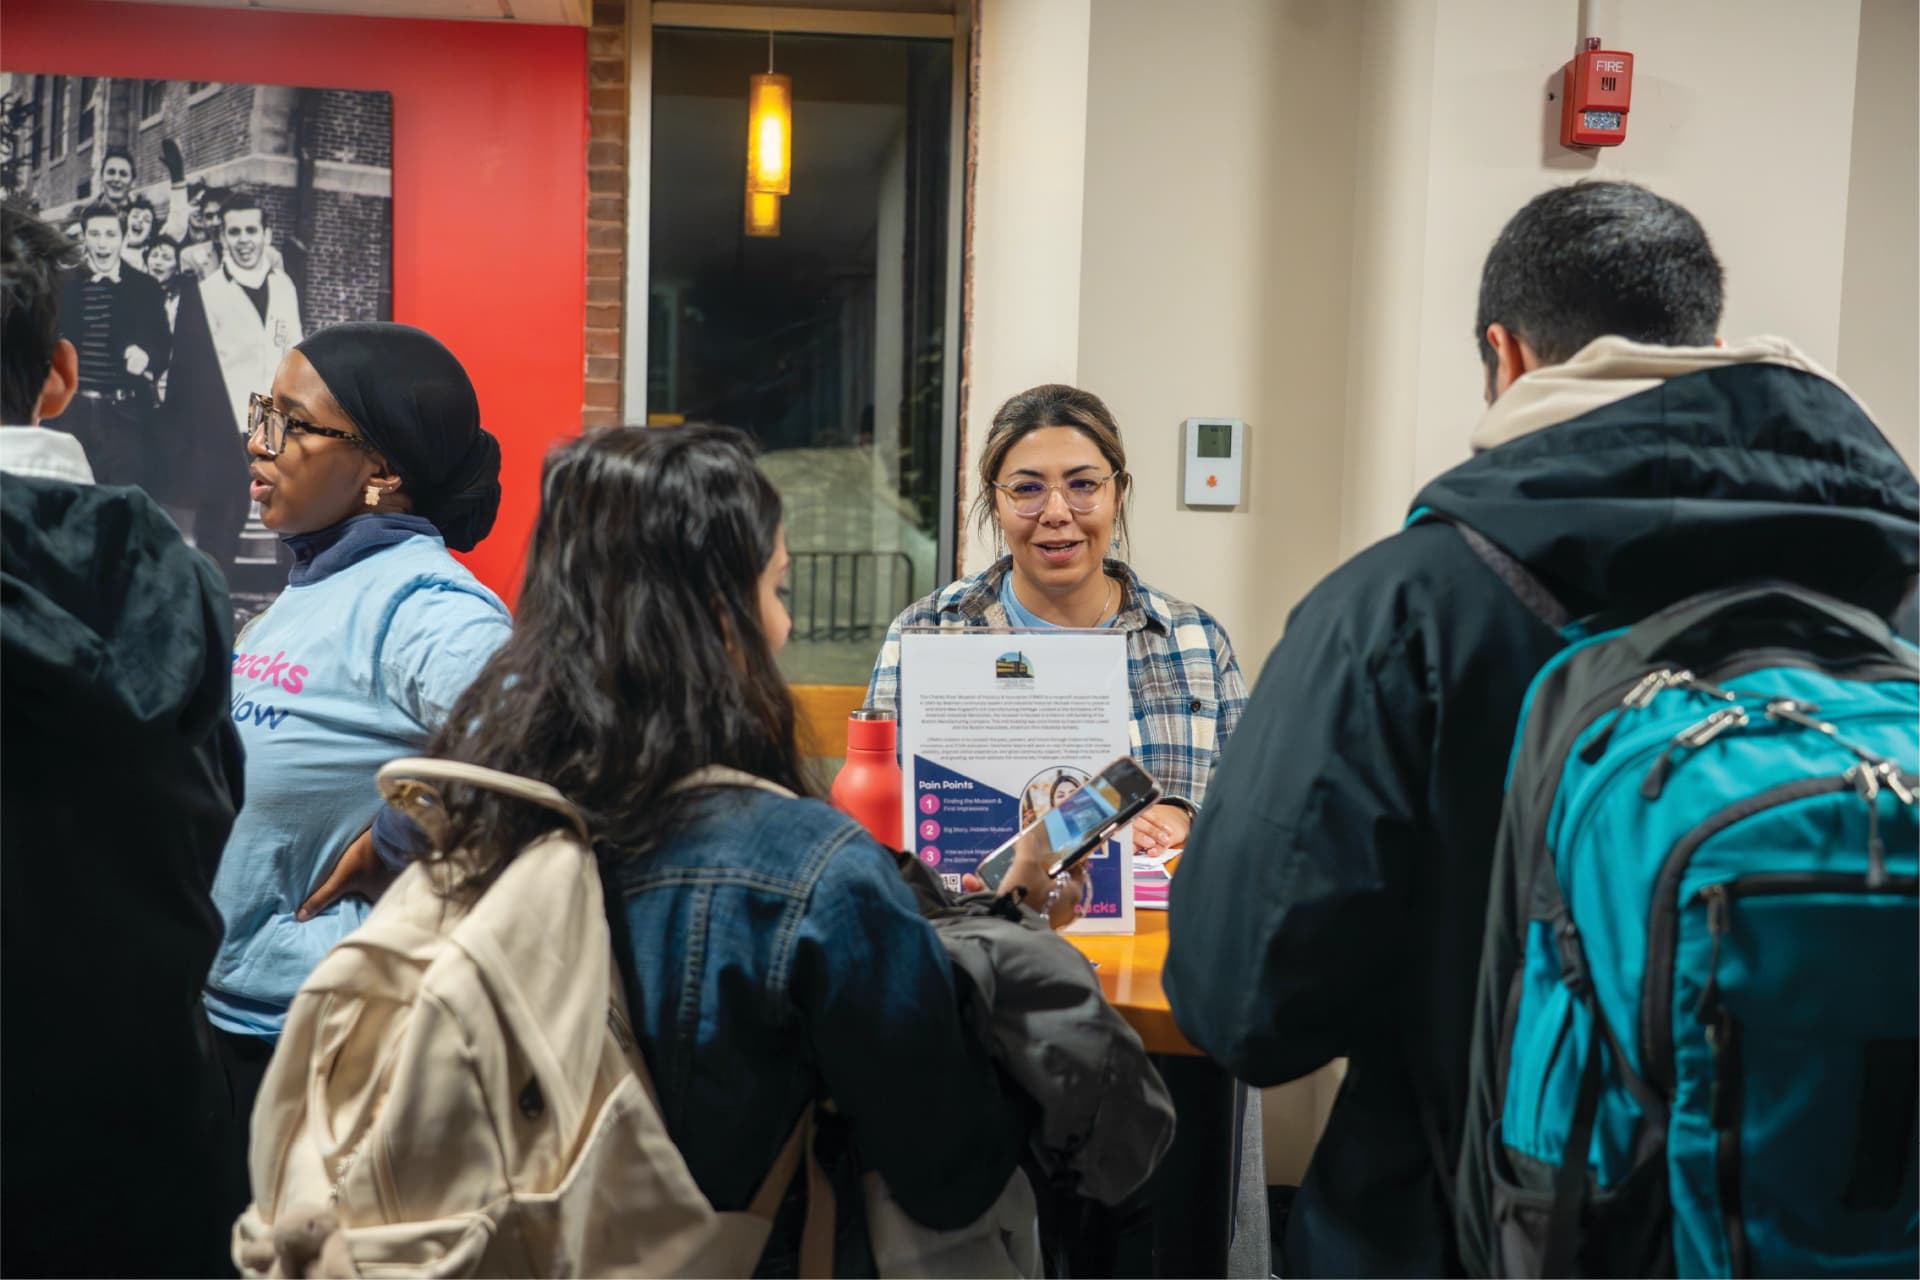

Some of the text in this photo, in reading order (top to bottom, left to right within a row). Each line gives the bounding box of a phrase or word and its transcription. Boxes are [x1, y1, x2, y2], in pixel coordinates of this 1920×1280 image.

[1596, 60, 1625, 73] FIRE
[919, 780, 974, 790] Pain Points
[925, 799, 932, 809] 1
[925, 824, 934, 836] 2
[926, 850, 934, 862] 3
